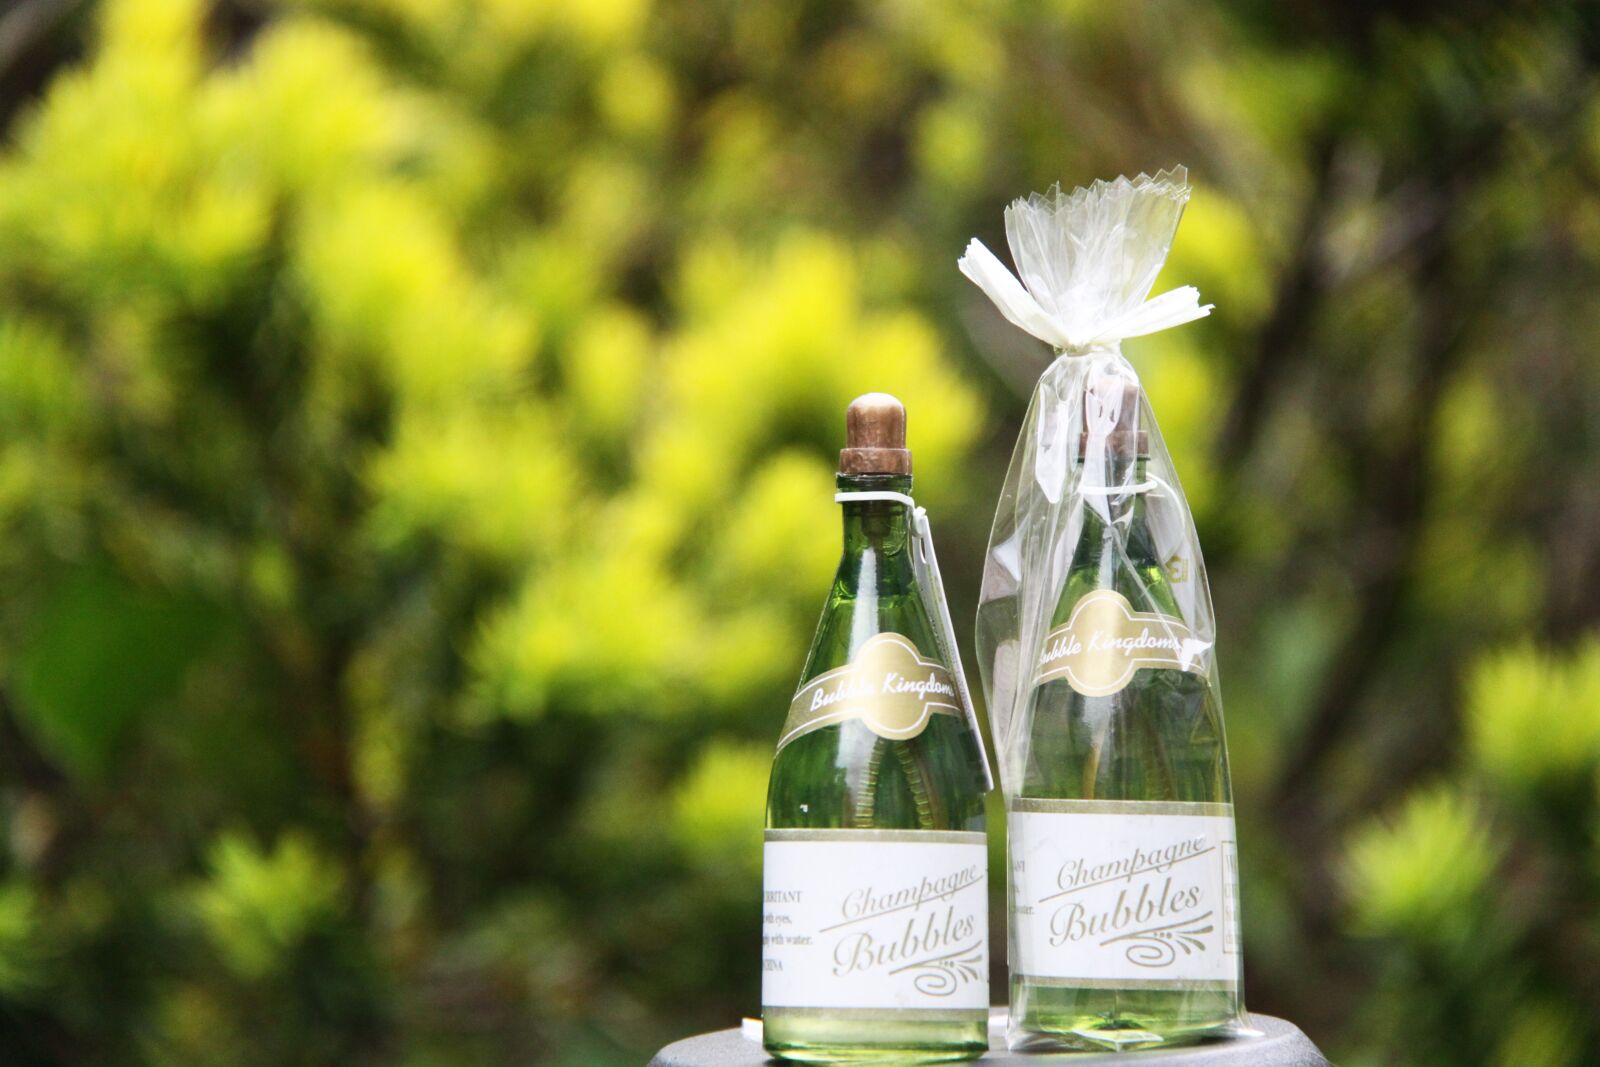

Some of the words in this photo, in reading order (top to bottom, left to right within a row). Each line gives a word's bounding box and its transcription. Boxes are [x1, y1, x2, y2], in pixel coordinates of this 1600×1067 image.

[841, 864, 978, 919] Champagne
[1056, 835, 1206, 890] Champagne
[832, 905, 975, 976] Bubbles
[1048, 876, 1201, 947] Bubbles
